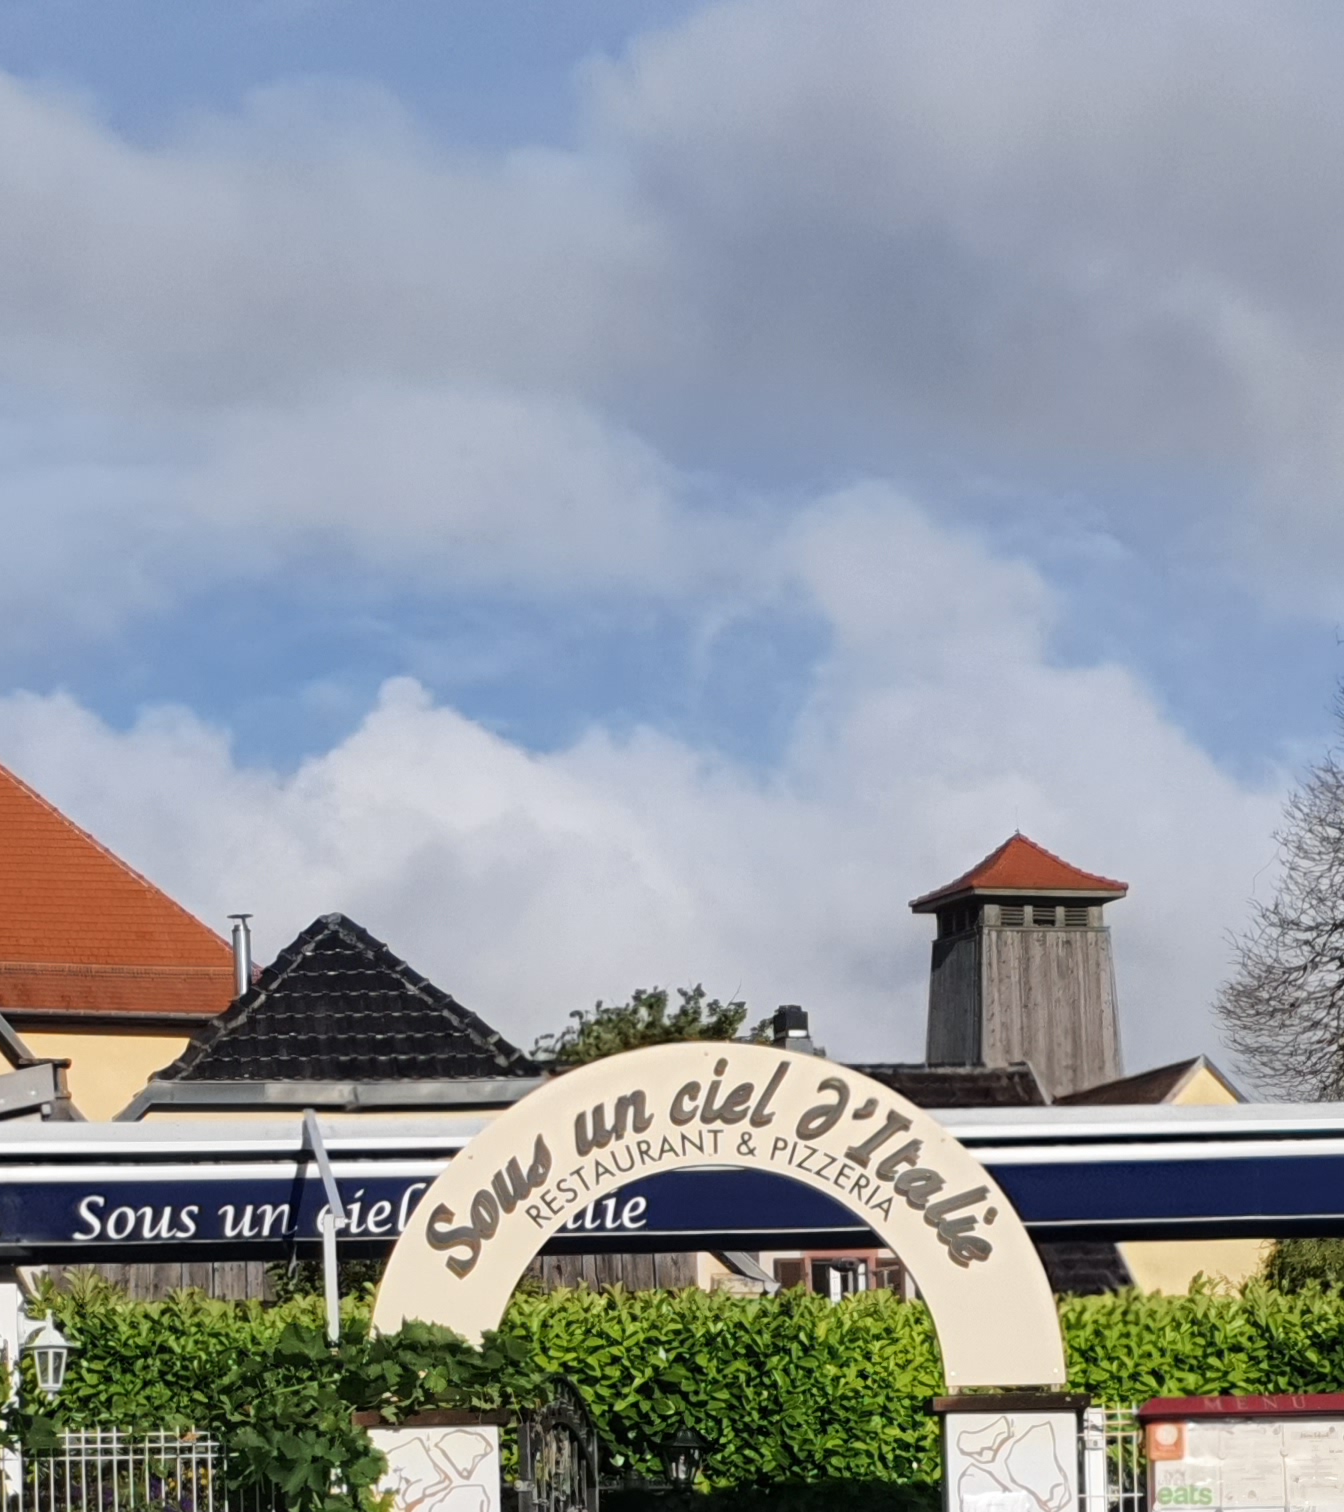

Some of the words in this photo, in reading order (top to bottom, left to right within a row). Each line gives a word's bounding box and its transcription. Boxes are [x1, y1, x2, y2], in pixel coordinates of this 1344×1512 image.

[426, 1134, 552, 1280] Sous
[574, 1090, 654, 1157] un
[669, 1058, 791, 1128] ciel
[525, 1129, 724, 1229] RESTAURANT
[736, 1131, 757, 1157] &
[770, 1136, 894, 1222] PIZZERIA
[72, 1196, 199, 1240] Sous
[218, 1202, 299, 1238] un
[316, 1183, 427, 1234] ciel
[1203, 1395, 1307, 1411] MENU
[1156, 1484, 1213, 1506] eats
